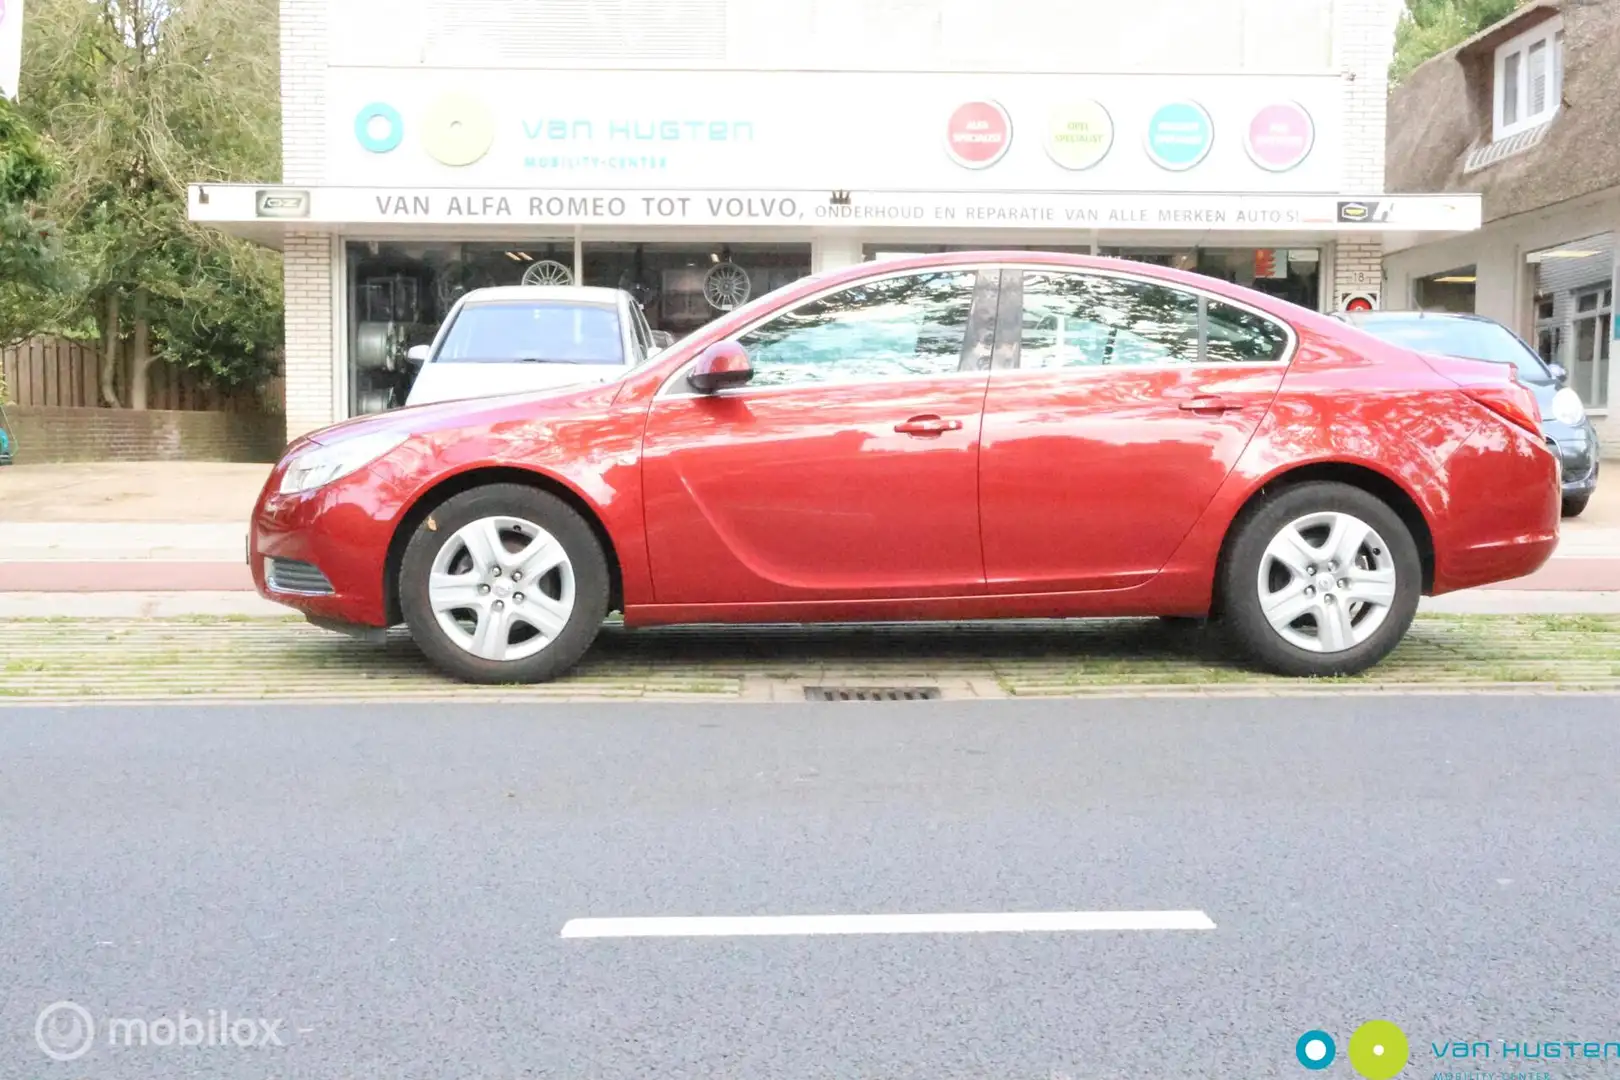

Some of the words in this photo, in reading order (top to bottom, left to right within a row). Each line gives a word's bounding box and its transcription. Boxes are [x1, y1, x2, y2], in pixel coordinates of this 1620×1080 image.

[1054, 134, 1104, 144] SPECIALIST
[375, 196, 430, 215] VAN
[447, 196, 512, 216] ALFA
[529, 197, 627, 217] ROMEO
[643, 197, 691, 217] TOT
[707, 197, 804, 219] VOLVO,
[814, 205, 925, 219] ONDERHOUD
[934, 206, 955, 219] EN
[966, 207, 1055, 220] REPARATIE
[1065, 208, 1098, 221] VAN
[1108, 209, 1147, 221] ALLE
[1158, 209, 1226, 222] MERKEN
[1353, 272, 1365, 282] 18
